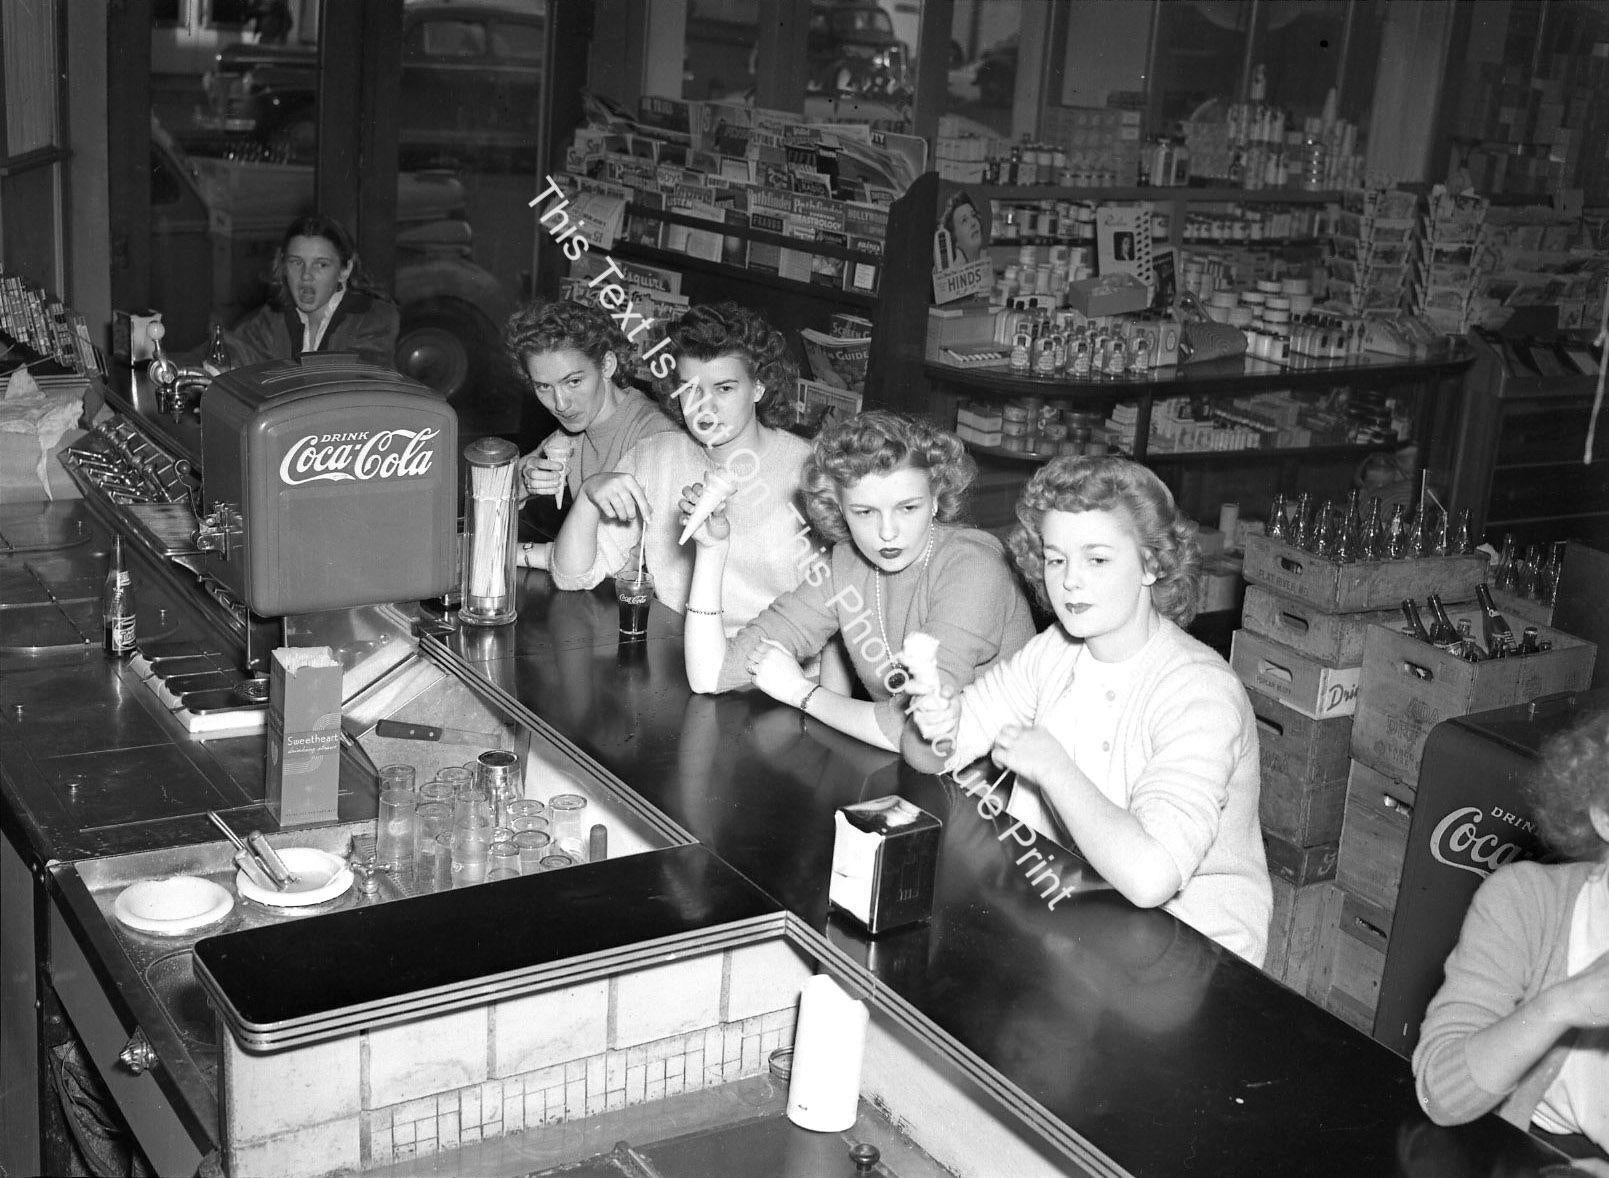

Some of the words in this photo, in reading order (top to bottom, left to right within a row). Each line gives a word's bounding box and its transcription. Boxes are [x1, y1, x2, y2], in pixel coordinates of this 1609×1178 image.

[947, 268, 982, 293] HINDS
[320, 431, 370, 443] DRINK
[279, 427, 441, 486] Coca-Cola
[287, 733, 338, 746] Sweetheart
[1491, 806, 1535, 833] DRIN
